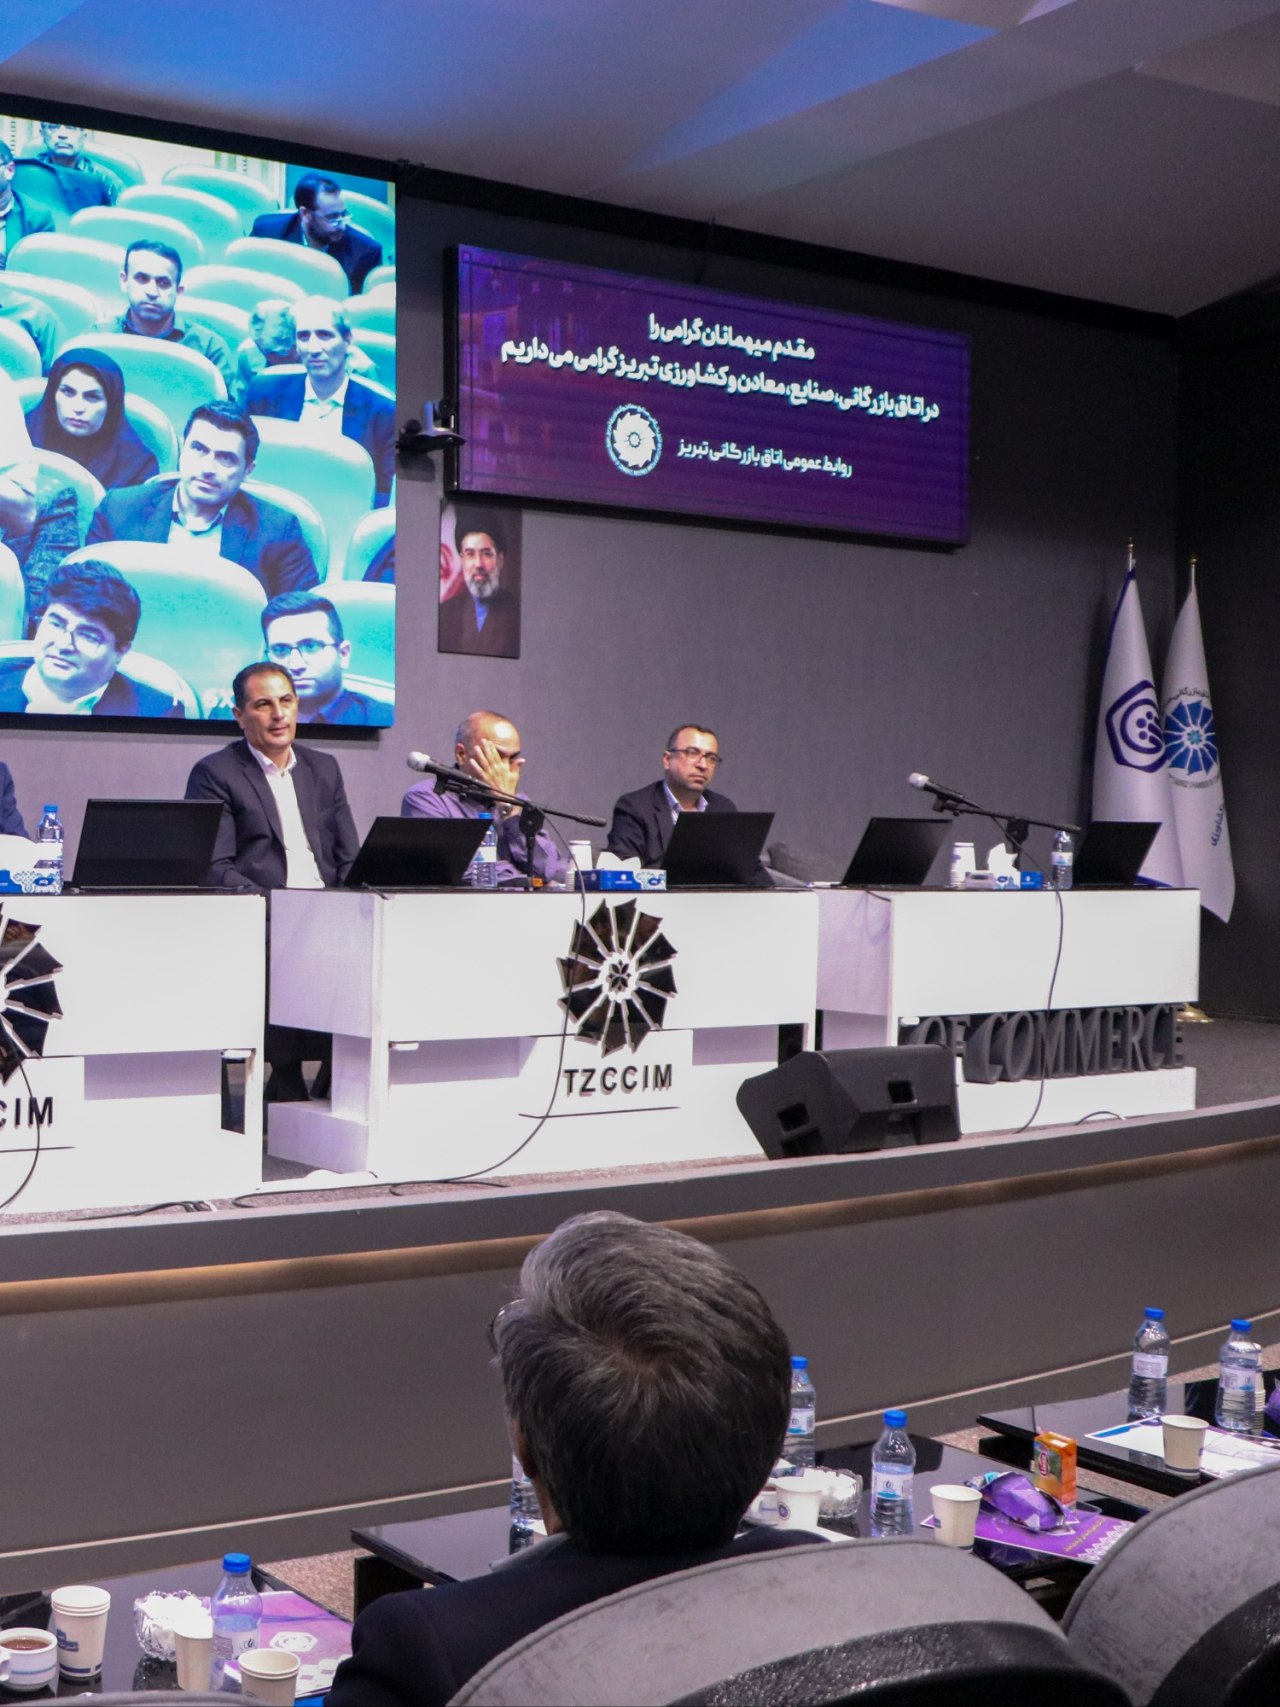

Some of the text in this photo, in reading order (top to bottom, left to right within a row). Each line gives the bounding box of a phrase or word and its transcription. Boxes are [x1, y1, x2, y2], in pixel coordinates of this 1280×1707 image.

[648, 312, 816, 362] مقدم میهمانان گرامی را
[572, 345, 620, 375] گرامی
[619, 354, 660, 381] تبریز
[658, 361, 729, 387] کشاورزی
[737, 371, 785, 394] معادن
[894, 395, 924, 418] اتاق
[921, 402, 940, 422] در
[677, 438, 853, 477] روابط عمومی اتاق بازرگانی تبریز
[964, 1003, 1186, 1084] COMMERCE
[564, 1064, 673, 1094] TZCCIM
